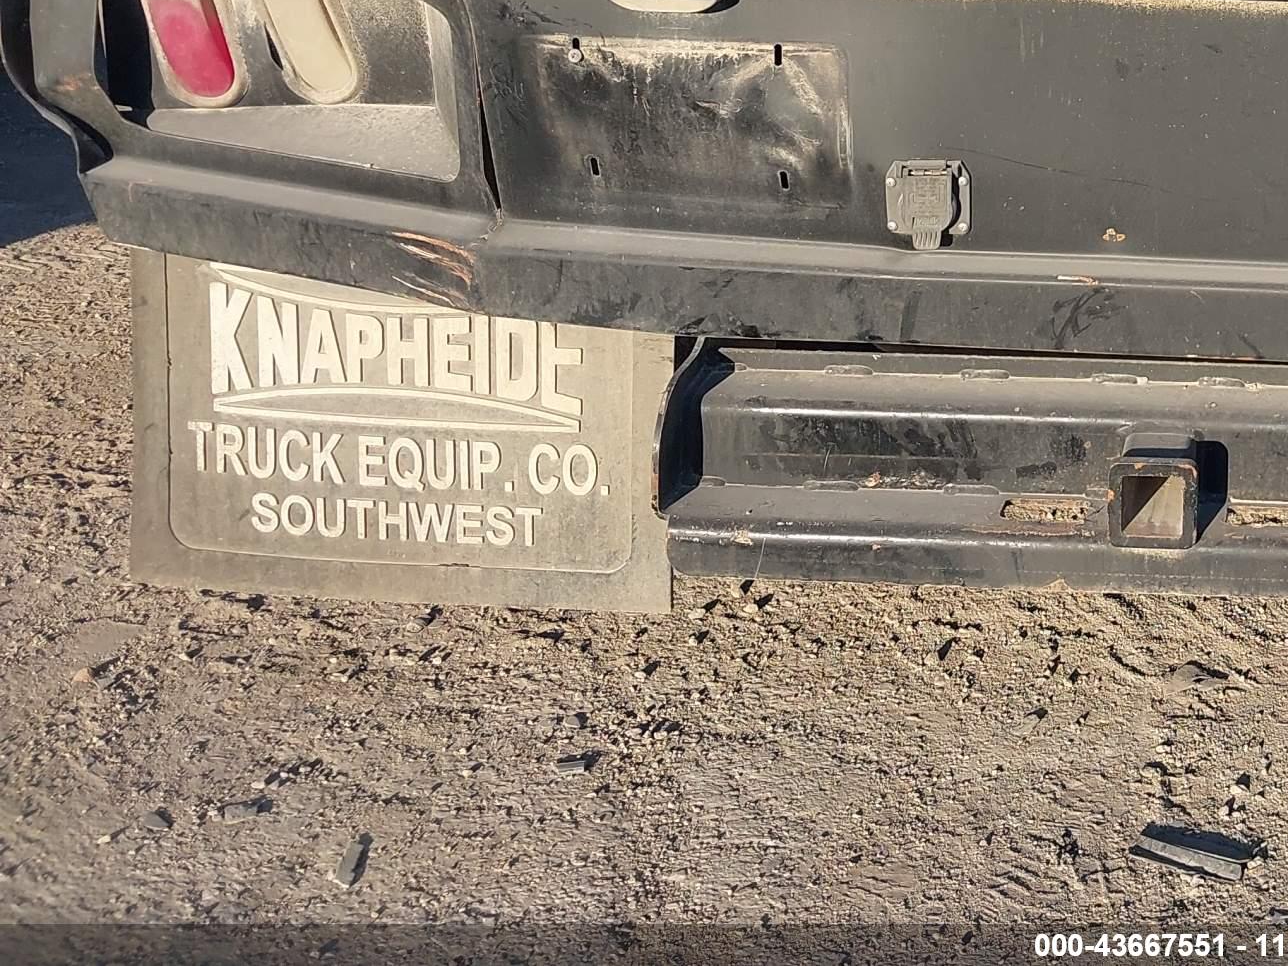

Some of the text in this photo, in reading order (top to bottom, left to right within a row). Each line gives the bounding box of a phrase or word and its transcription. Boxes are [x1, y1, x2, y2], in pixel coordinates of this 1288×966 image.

[208, 282, 583, 415] KNAPHEIDE
[187, 420, 611, 496] TRUCK EQUIP. CO.
[250, 492, 543, 547] SOUTHWEST
